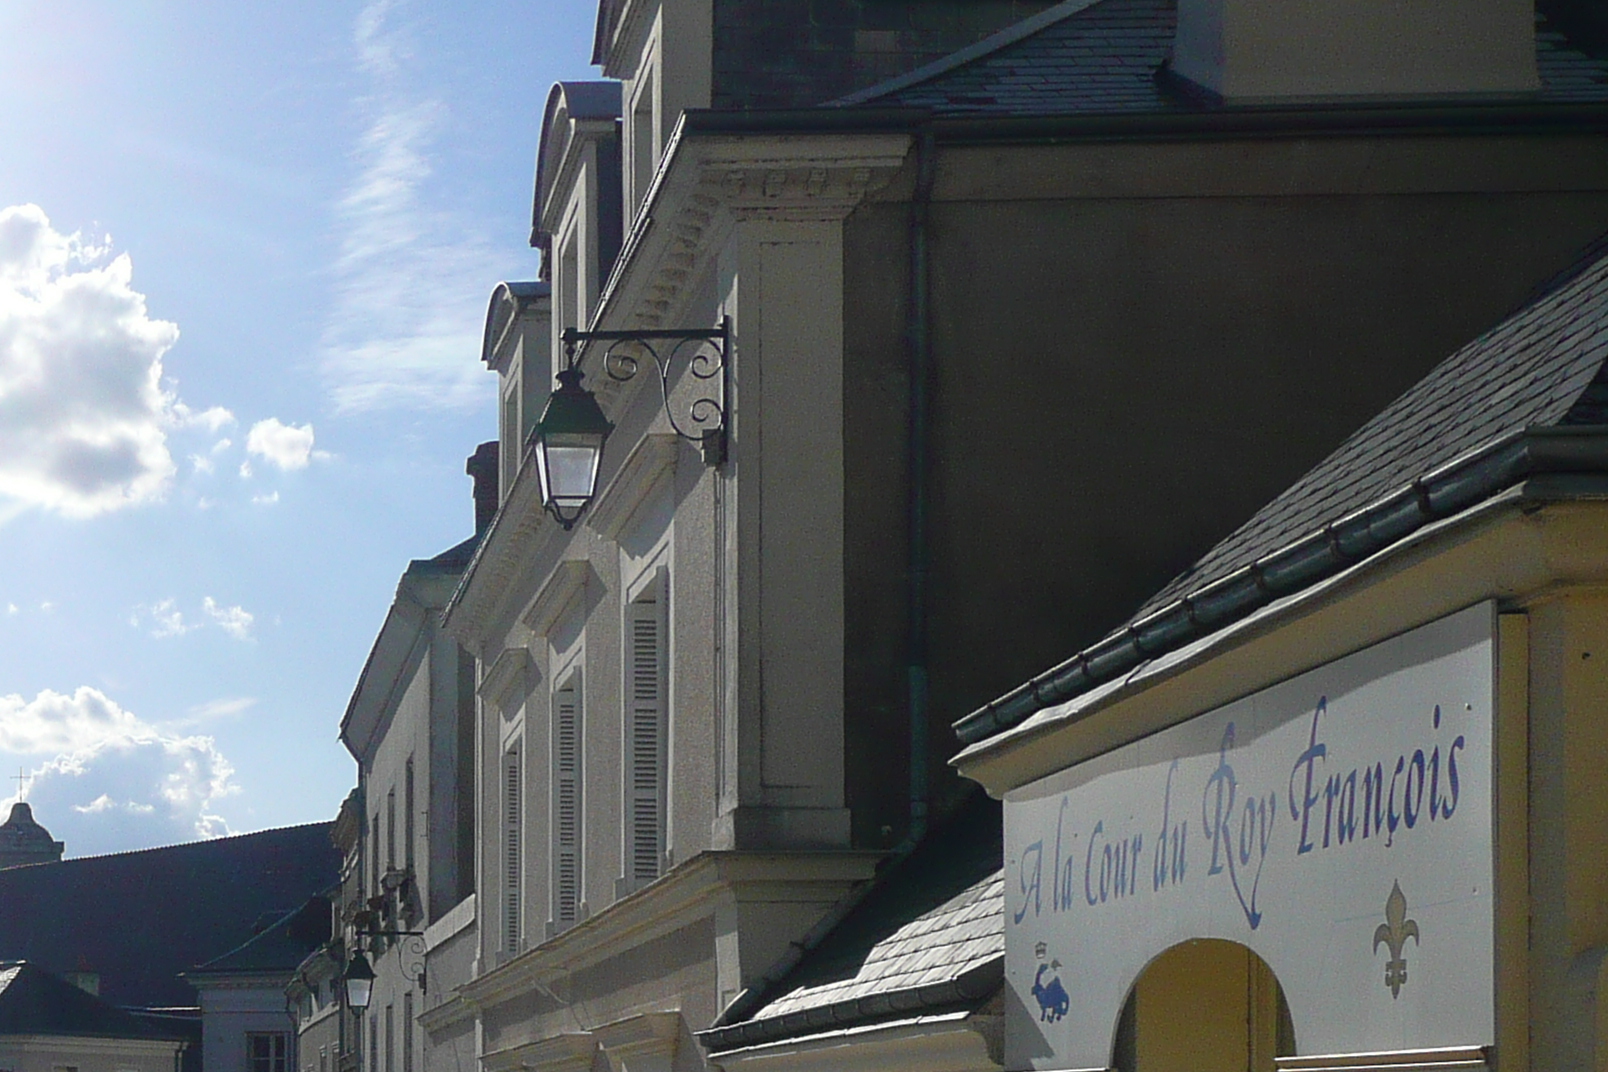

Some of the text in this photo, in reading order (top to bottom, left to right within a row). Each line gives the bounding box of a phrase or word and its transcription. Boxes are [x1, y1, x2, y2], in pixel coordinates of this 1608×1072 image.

[1014, 694, 1465, 931] A la Cour du Roy François
